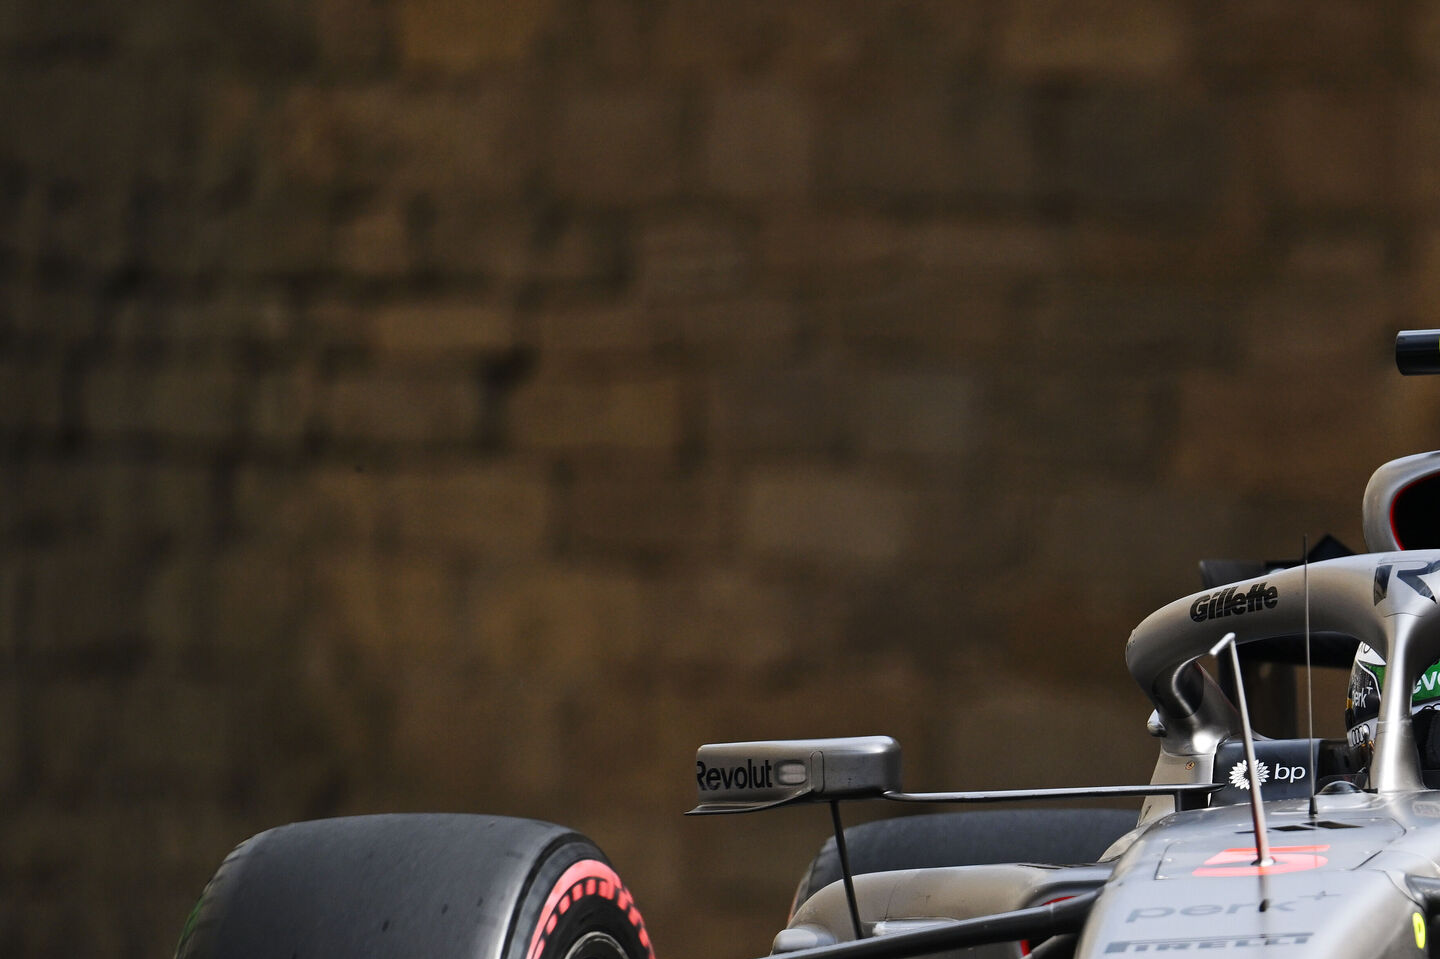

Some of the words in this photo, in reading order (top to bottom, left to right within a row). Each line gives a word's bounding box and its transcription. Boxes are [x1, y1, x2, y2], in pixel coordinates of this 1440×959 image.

[1189, 582, 1279, 623] Gillette
[696, 758, 774, 791] Revolut
[1274, 763, 1306, 784] bp
[1191, 844, 1331, 877] 5
[1103, 932, 1315, 954] PIRELLI
